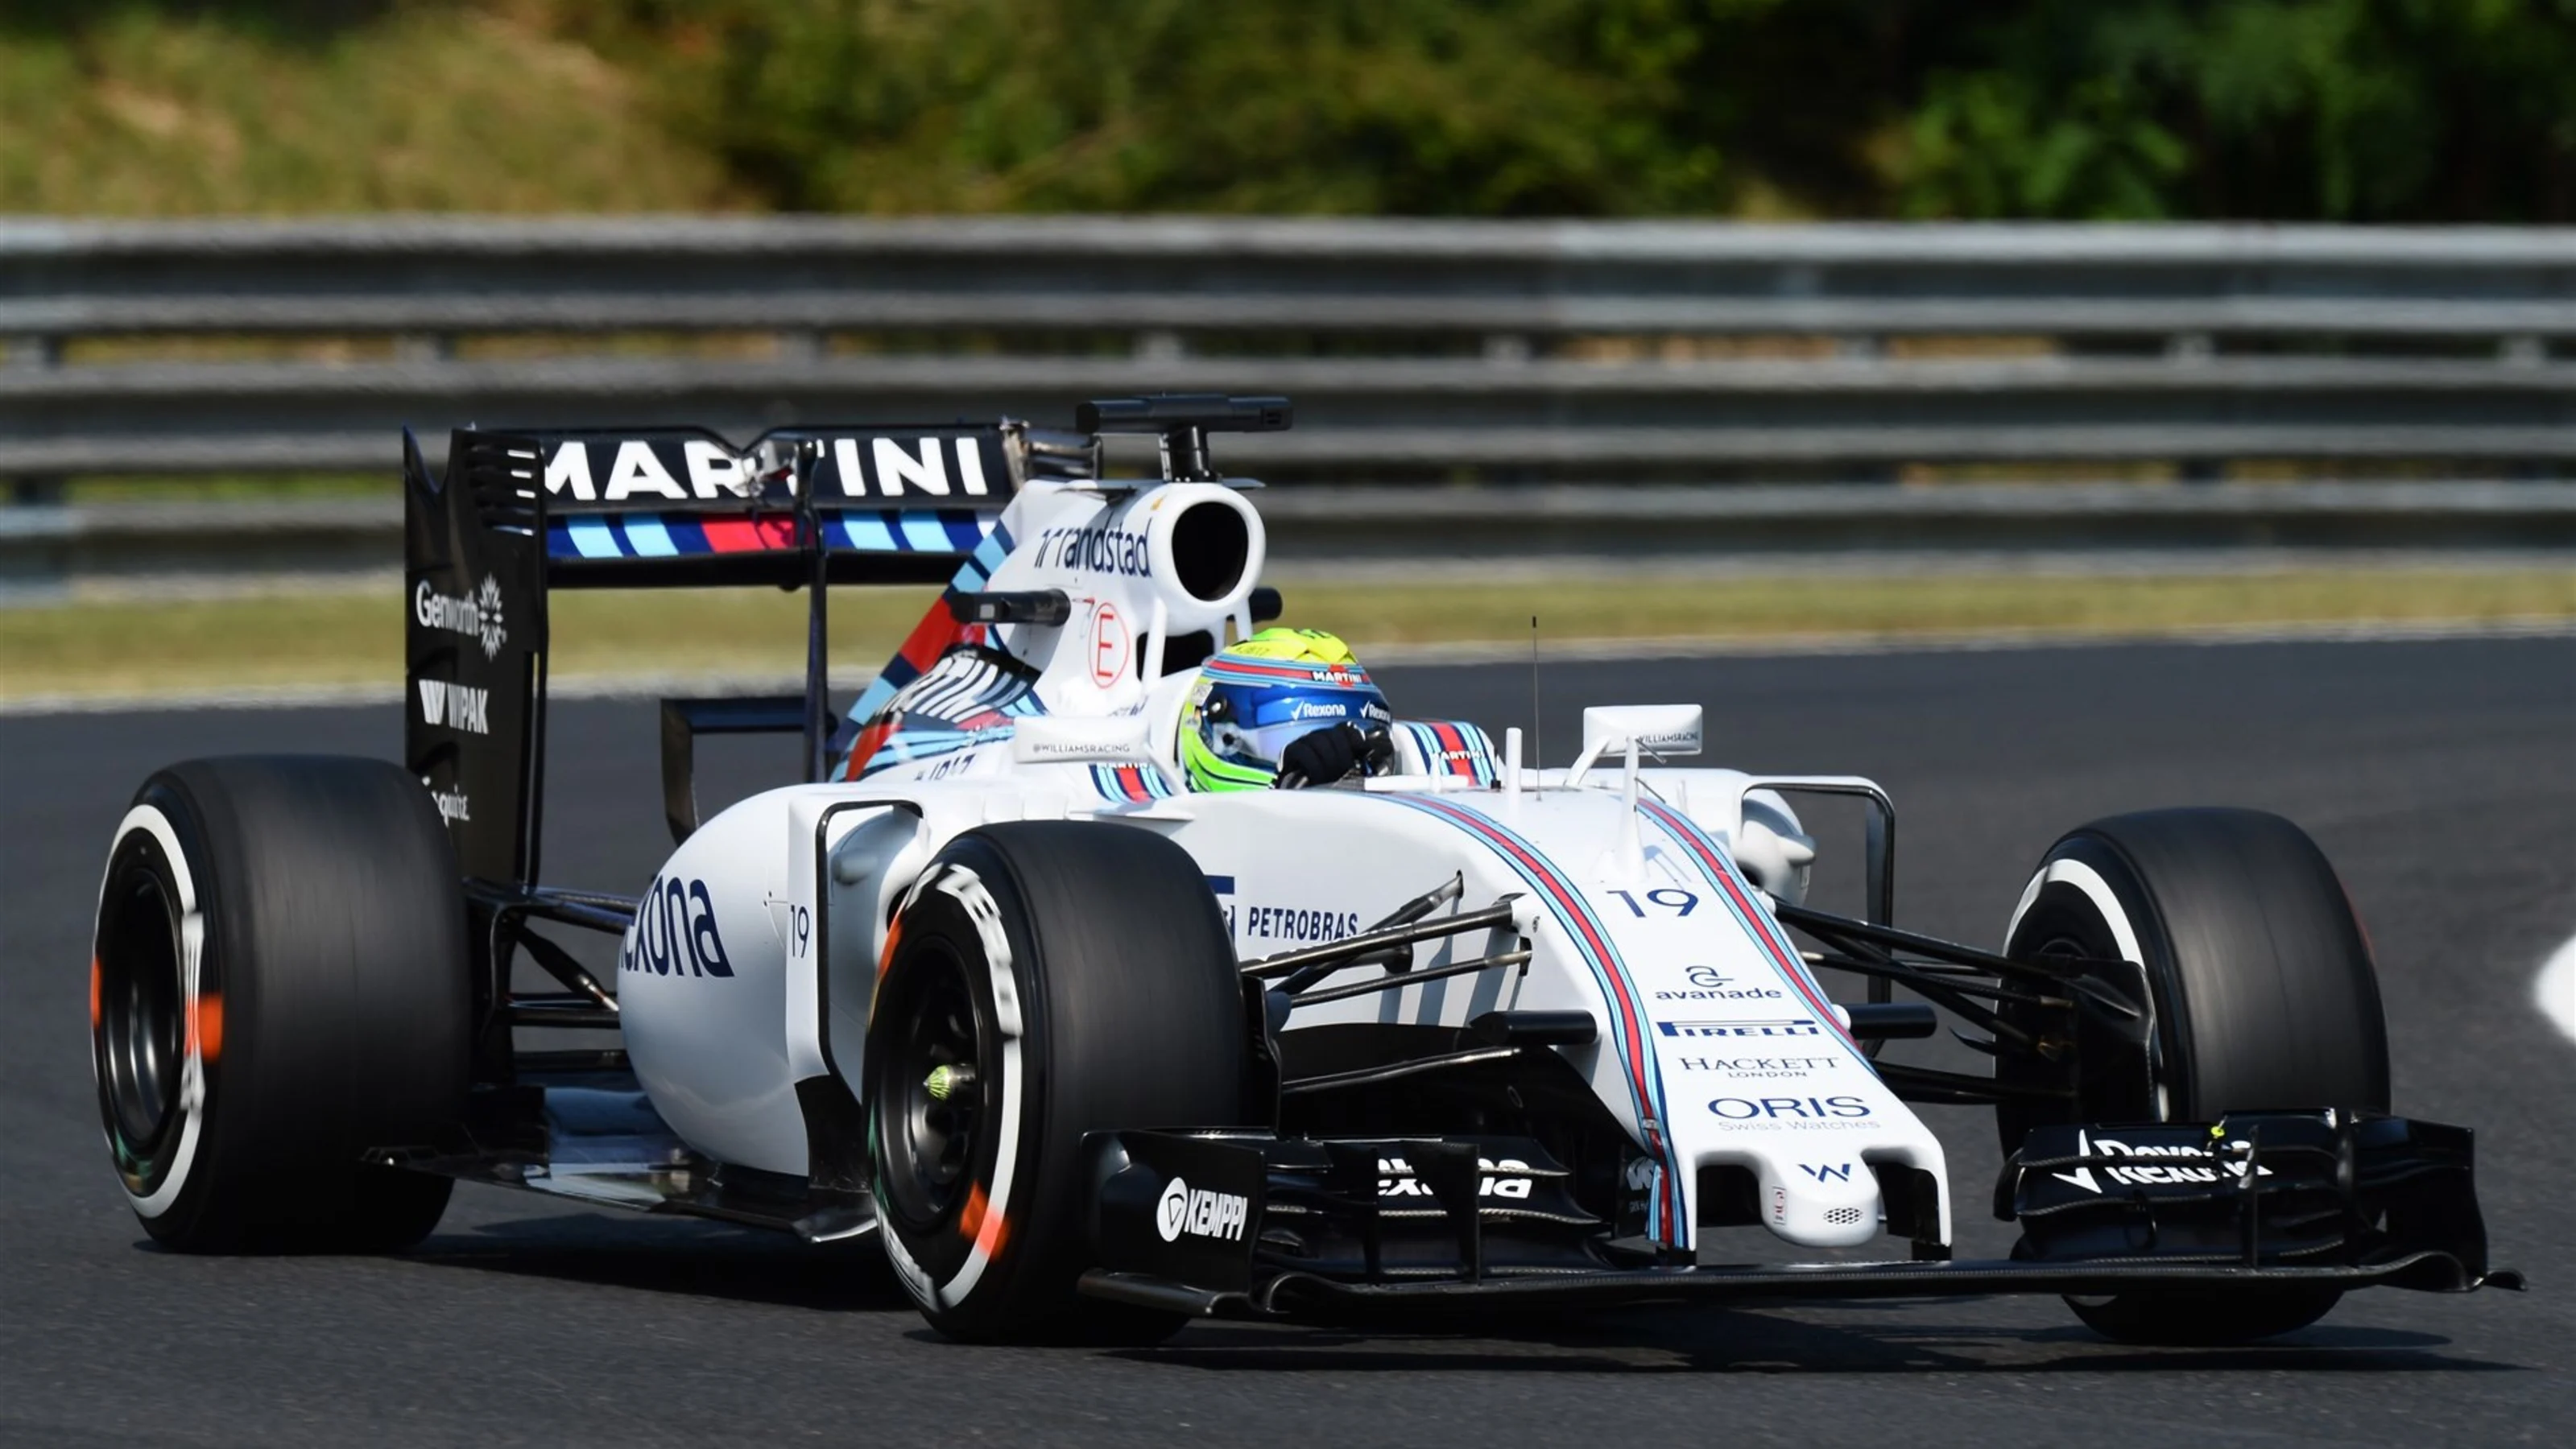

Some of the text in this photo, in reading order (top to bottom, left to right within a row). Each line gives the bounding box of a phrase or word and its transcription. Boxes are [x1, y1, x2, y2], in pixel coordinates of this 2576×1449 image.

[1055, 510, 1152, 578] randstad
[416, 580, 479, 637] Genworth
[1097, 613, 1114, 678] E
[1312, 671, 1362, 684] MARTINI
[447, 683, 490, 734] WIPAK
[1303, 703, 1346, 718] Rexona
[1369, 703, 1391, 723] Rexon
[1032, 743, 1131, 754] @WILLIAMSRACING
[1627, 731, 1698, 745] WILLIAMSRACING
[1606, 888, 1699, 918] 19
[618, 874, 735, 978] exona
[791, 905, 810, 959] 19
[1248, 906, 1358, 941] PETROBRAS
[1656, 988, 1782, 1000] avanade
[1656, 1020, 1820, 1037] PIRELLI
[1707, 1096, 1871, 1120] ORIS
[1718, 1118, 1881, 1132] Swiss Watches
[1184, 1187, 1248, 1241] KEMPPI
